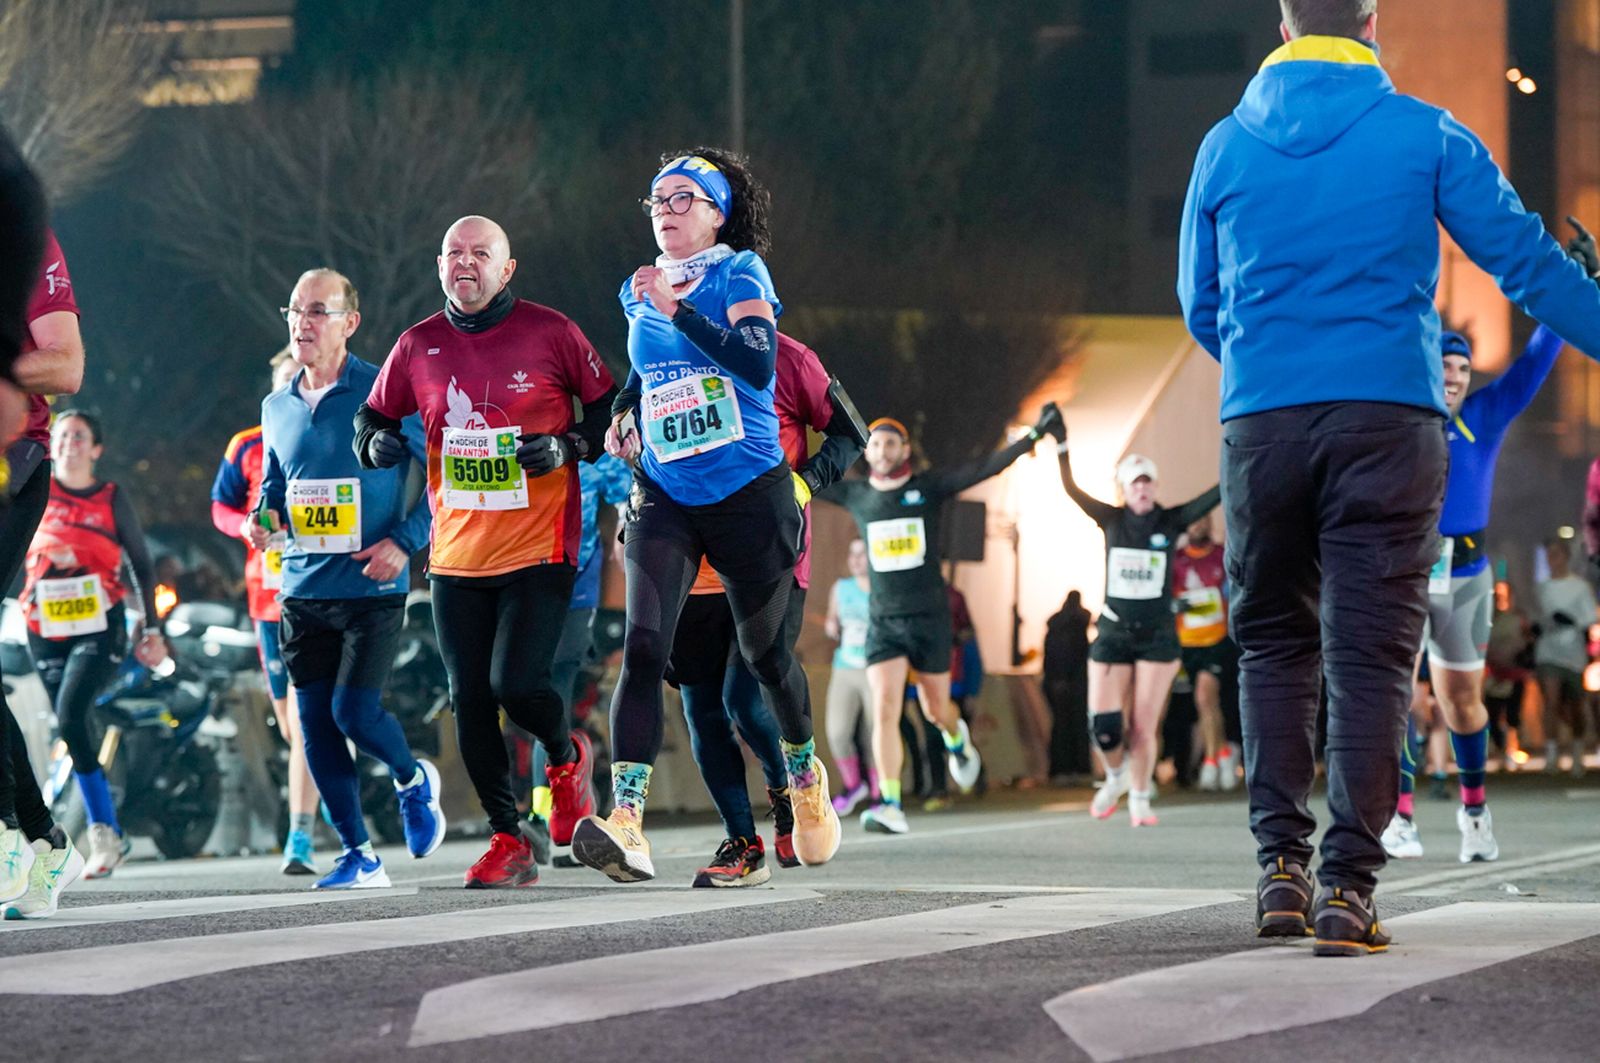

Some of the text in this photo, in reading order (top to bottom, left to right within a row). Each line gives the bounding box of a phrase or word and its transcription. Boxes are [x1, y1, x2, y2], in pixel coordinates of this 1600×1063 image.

[660, 388, 684, 404] NOCHE
[686, 385, 696, 397] DE
[653, 405, 668, 420] SAN
[663, 403, 722, 443] 6764
[448, 447, 461, 456] SAN
[455, 438, 488, 448] NOCHE DE
[453, 457, 509, 483] 5509
[319, 487, 329, 495] DE
[305, 506, 339, 528] 244
